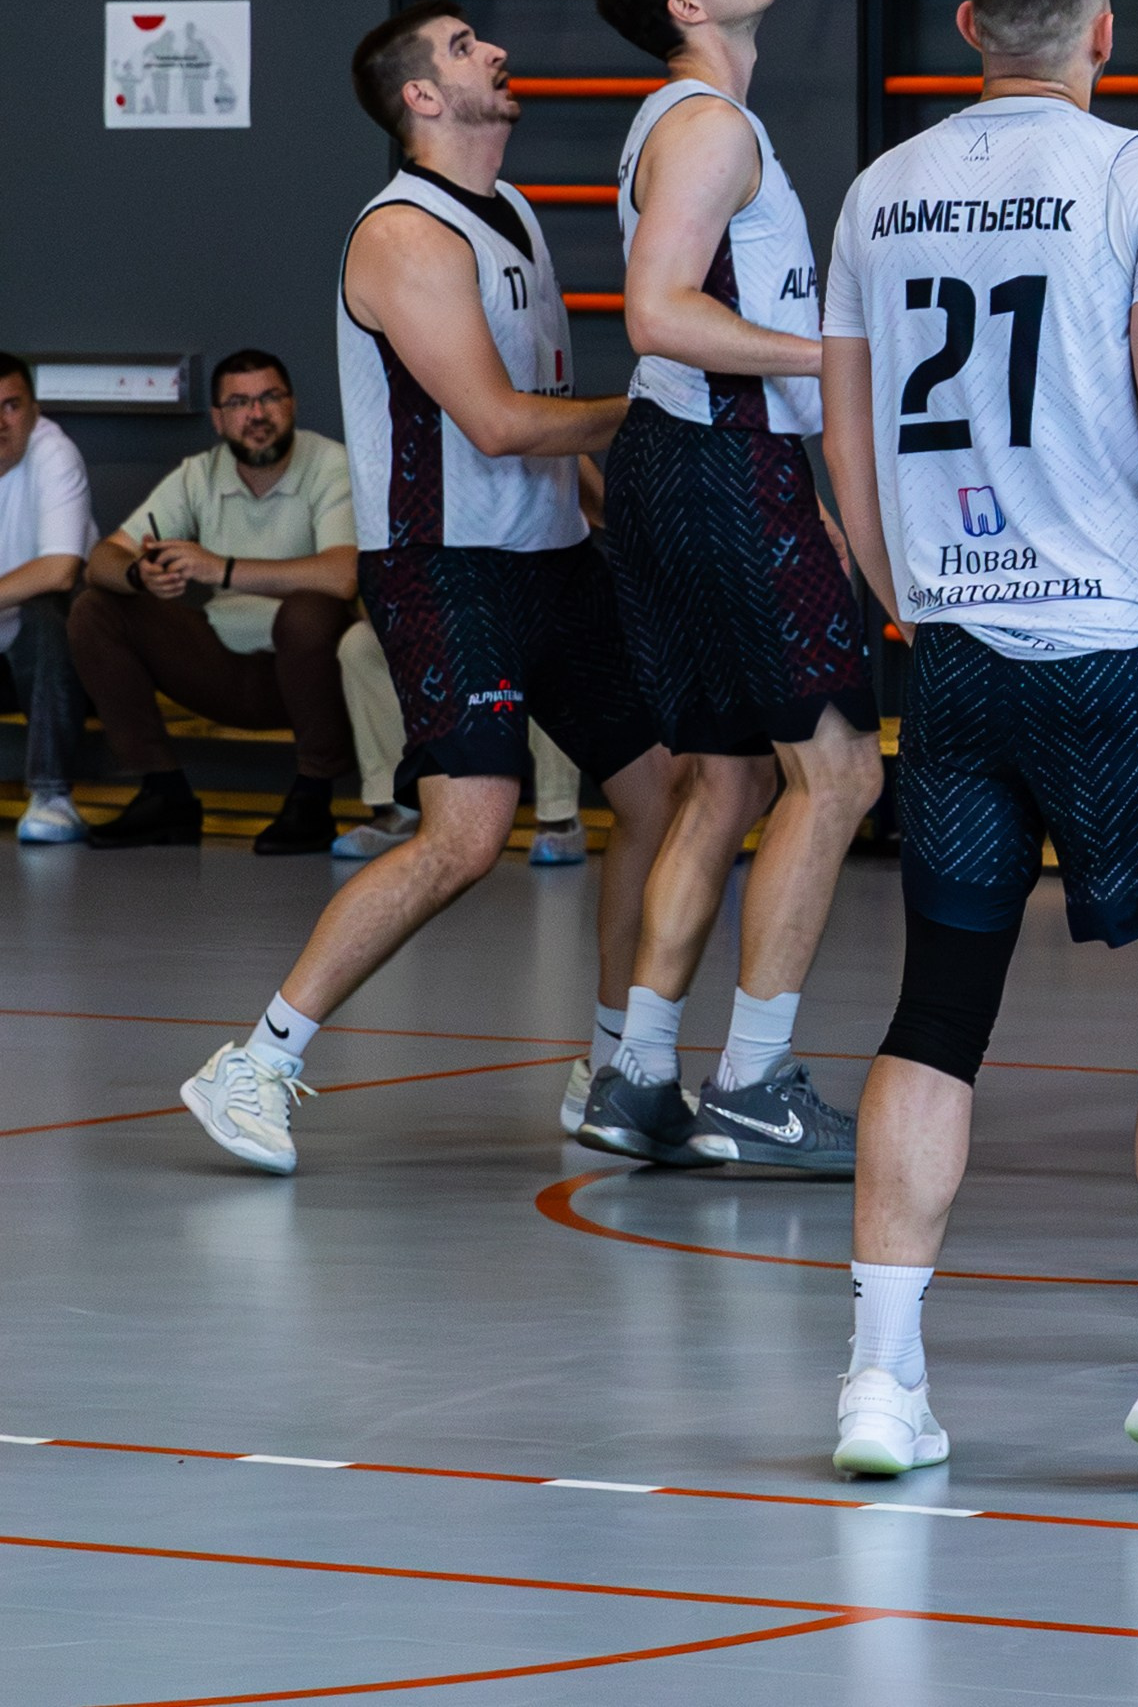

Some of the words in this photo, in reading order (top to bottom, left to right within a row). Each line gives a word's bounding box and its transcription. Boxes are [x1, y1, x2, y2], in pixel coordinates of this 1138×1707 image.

[870, 196, 1077, 241] АЛЬМЕТЬЕВСК
[503, 266, 528, 311] 17
[898, 274, 1048, 455] 21
[938, 543, 1040, 577] Новая
